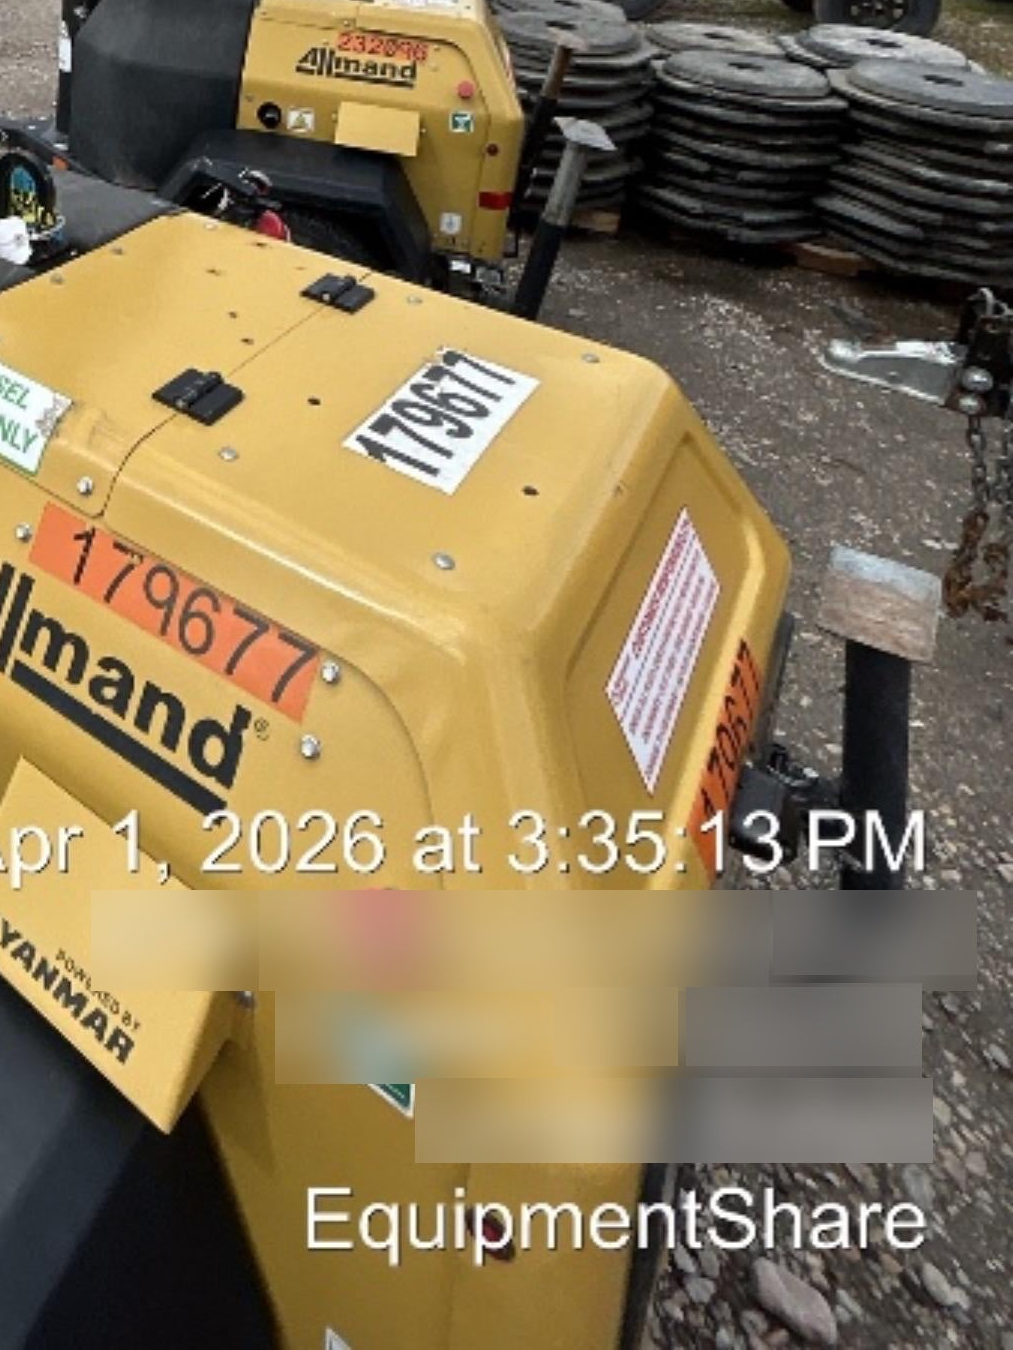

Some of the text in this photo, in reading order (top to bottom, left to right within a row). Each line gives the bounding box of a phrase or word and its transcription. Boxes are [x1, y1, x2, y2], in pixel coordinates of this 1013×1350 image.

[295, 47, 418, 88] Allmand
[354, 349, 517, 477] 179677
[71, 527, 320, 704] 179677
